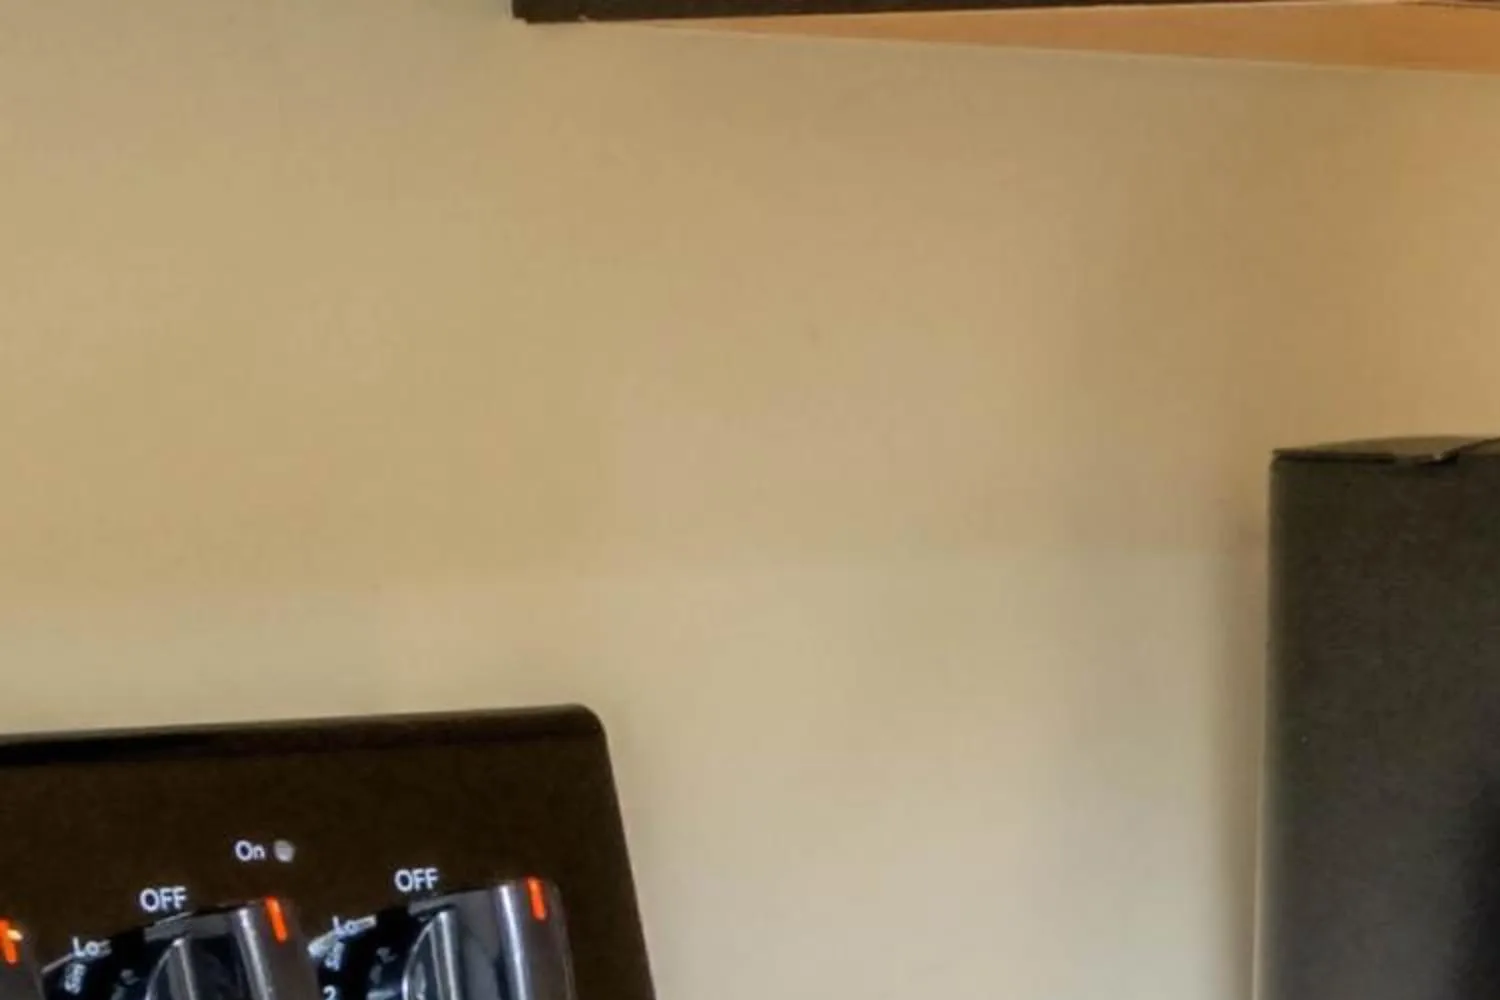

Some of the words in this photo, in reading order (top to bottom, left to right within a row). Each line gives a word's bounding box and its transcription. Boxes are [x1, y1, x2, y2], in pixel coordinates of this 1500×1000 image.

[234, 840, 265, 863] On
[395, 867, 438, 892] OFF
[140, 886, 186, 912] OFF
